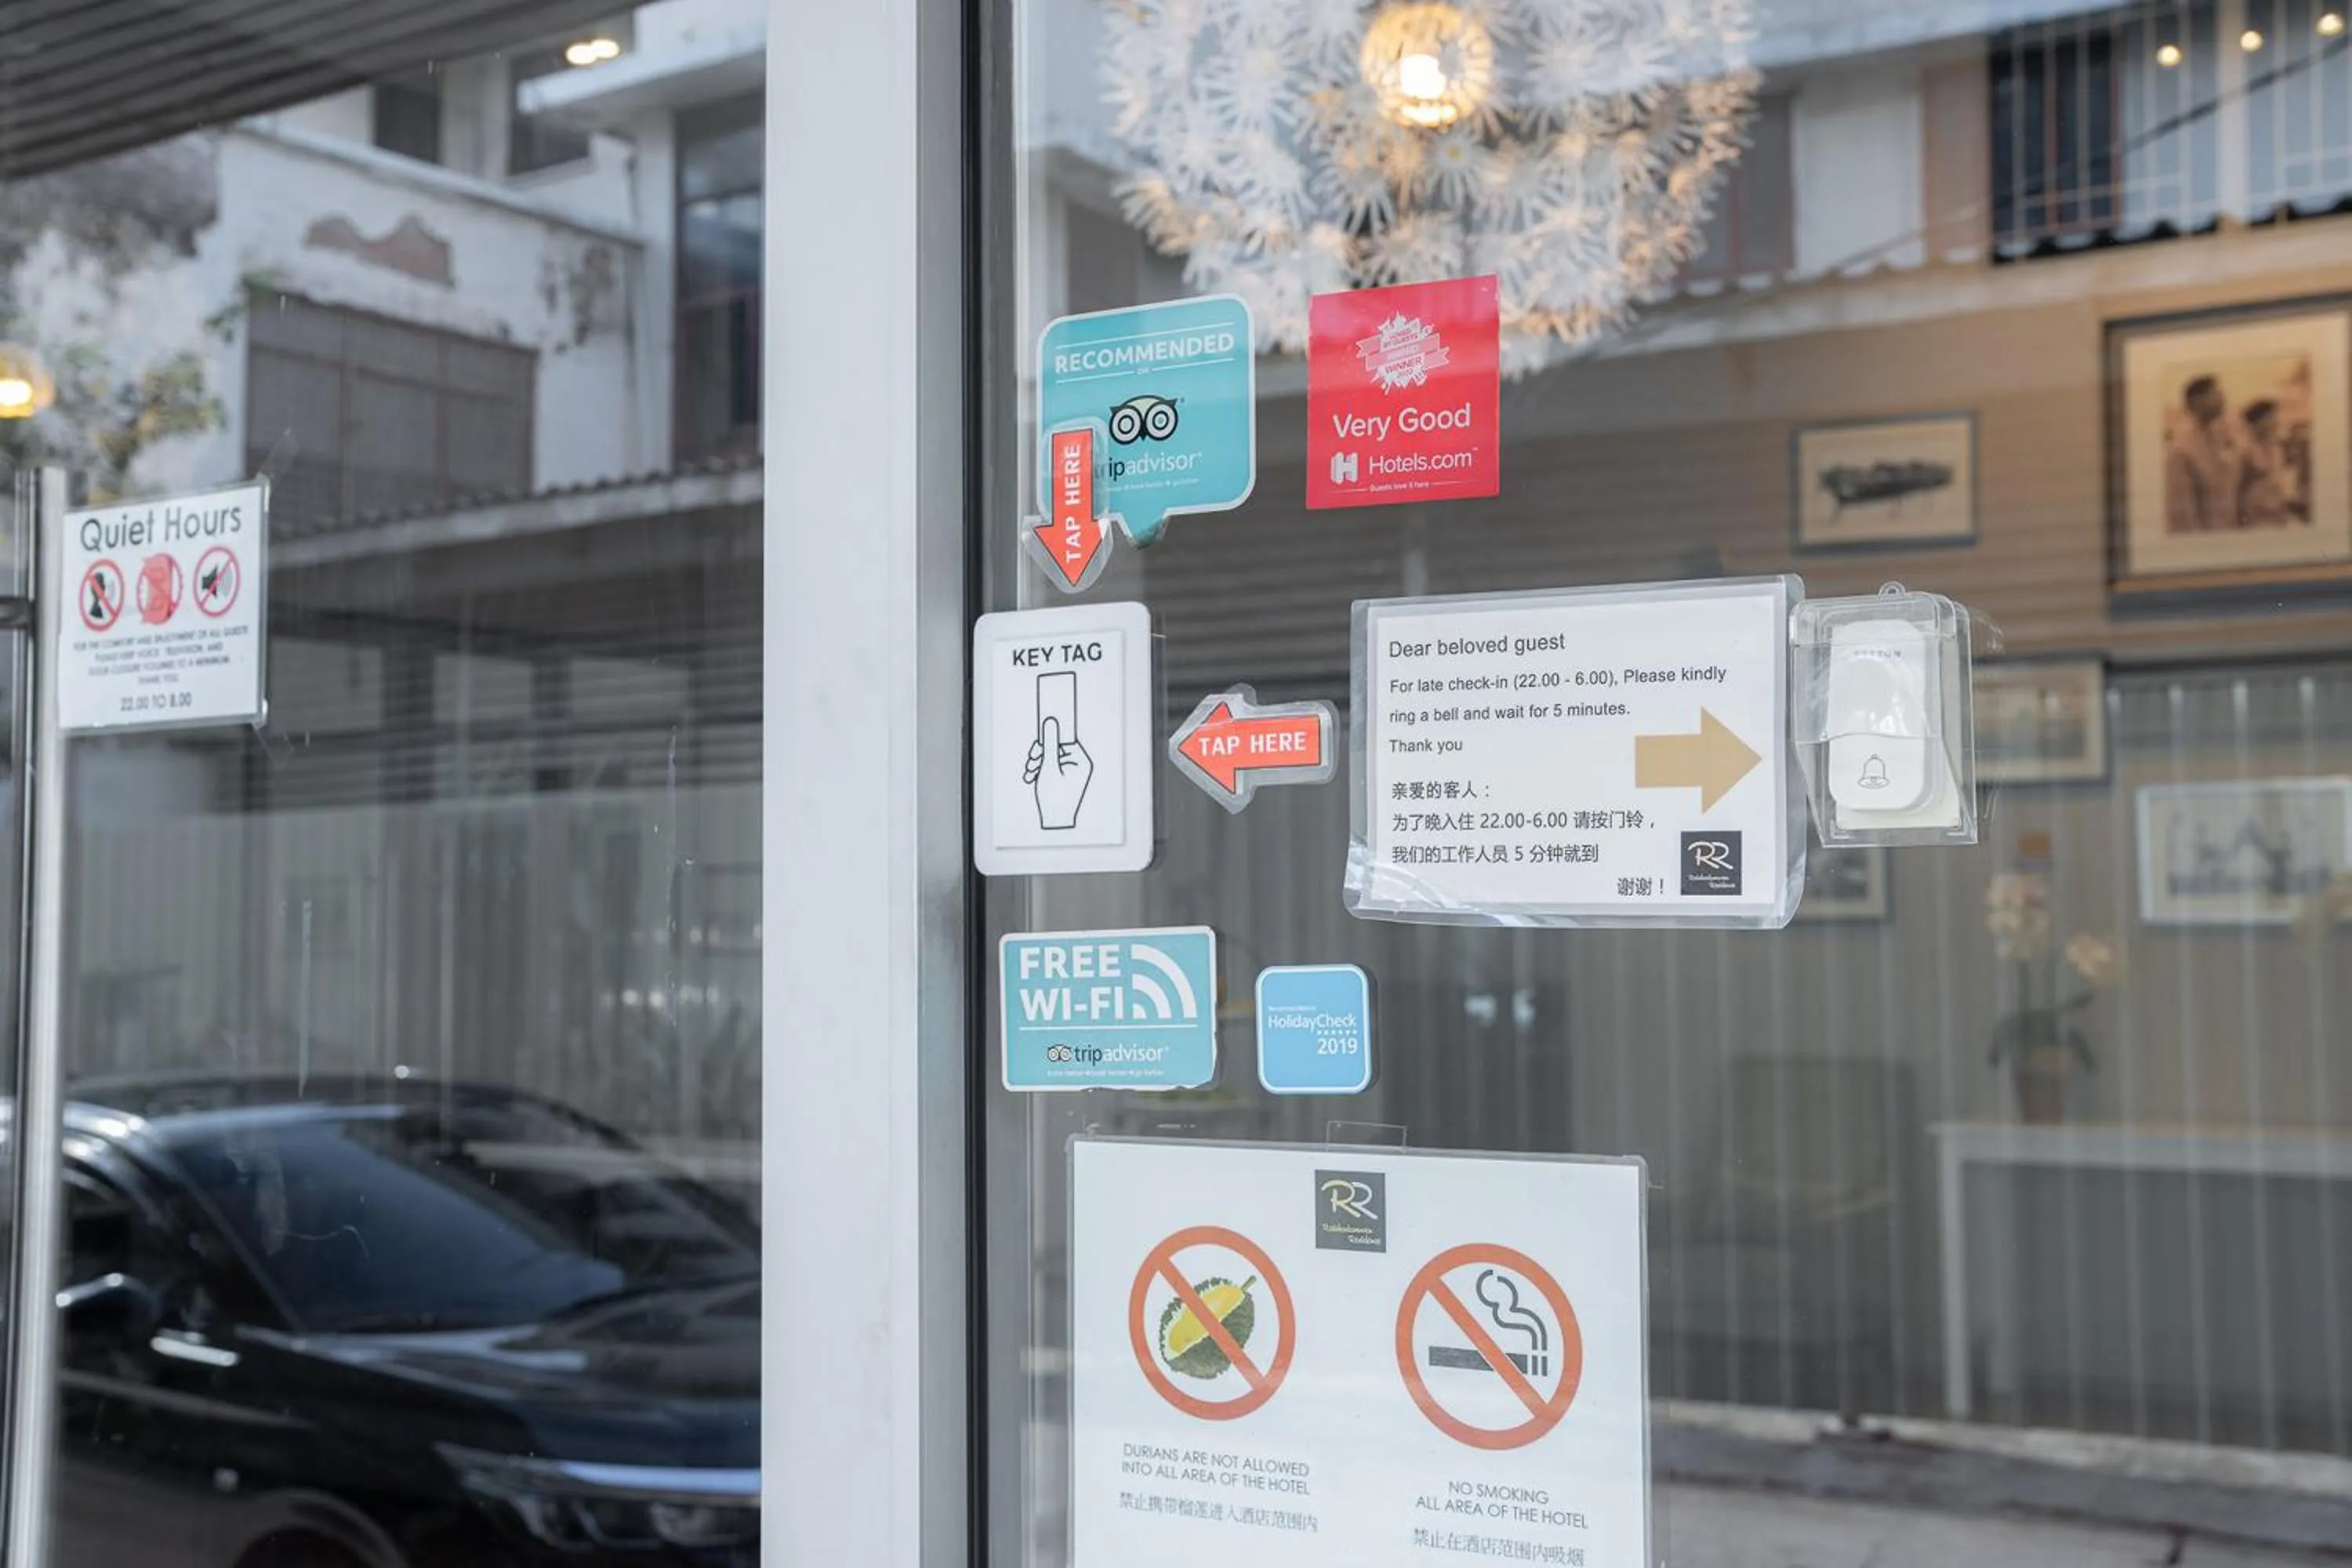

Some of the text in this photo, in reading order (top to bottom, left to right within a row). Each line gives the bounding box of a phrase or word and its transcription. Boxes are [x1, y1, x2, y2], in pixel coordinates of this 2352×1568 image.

[1054, 332, 1235, 374] RECOMMENDED
[1333, 402, 1471, 441] Very Good
[1369, 452, 1472, 474] Hotels.com
[1065, 444, 1081, 562] TAP HERE
[80, 506, 241, 552] Quiet Hours
[1013, 642, 1102, 666] KEY TAG
[1389, 633, 1566, 658] Dear beloved guest
[1390, 679, 1414, 692] For
[1417, 678, 1443, 691] late
[1448, 675, 1508, 691] check-in
[1514, 673, 1560, 690] (22.00
[1623, 669, 1675, 683] Please
[1681, 666, 1727, 683] kindly
[152, 695, 166, 708] TO
[1389, 702, 1631, 725] ring a bell and wait for 5 minutes.
[1199, 731, 1308, 757] TAP HERE
[1389, 739, 1463, 754] Thank you
[1392, 813, 1474, 832] 为了晚入住
[1479, 812, 1567, 829] 22.00-6.00
[1392, 844, 1599, 863] 我们的工作人员 5 分钟就到
[1020, 943, 1120, 980] FREE
[1019, 986, 1123, 1021] WI-FI
[1268, 1012, 1357, 1033] HolidayCheck
[1074, 1043, 1163, 1066] tripadvisor
[1317, 1037, 1357, 1054] 2019
[1123, 1443, 1310, 1477] DURIANS ARE NOT ALLOWED
[1122, 1461, 1311, 1495] INTO ALL AREA OF THE HOTEL
[1449, 1480, 1549, 1504] NO SMOKING
[1416, 1495, 1589, 1529] ALL AREA OF THE HOTEL
